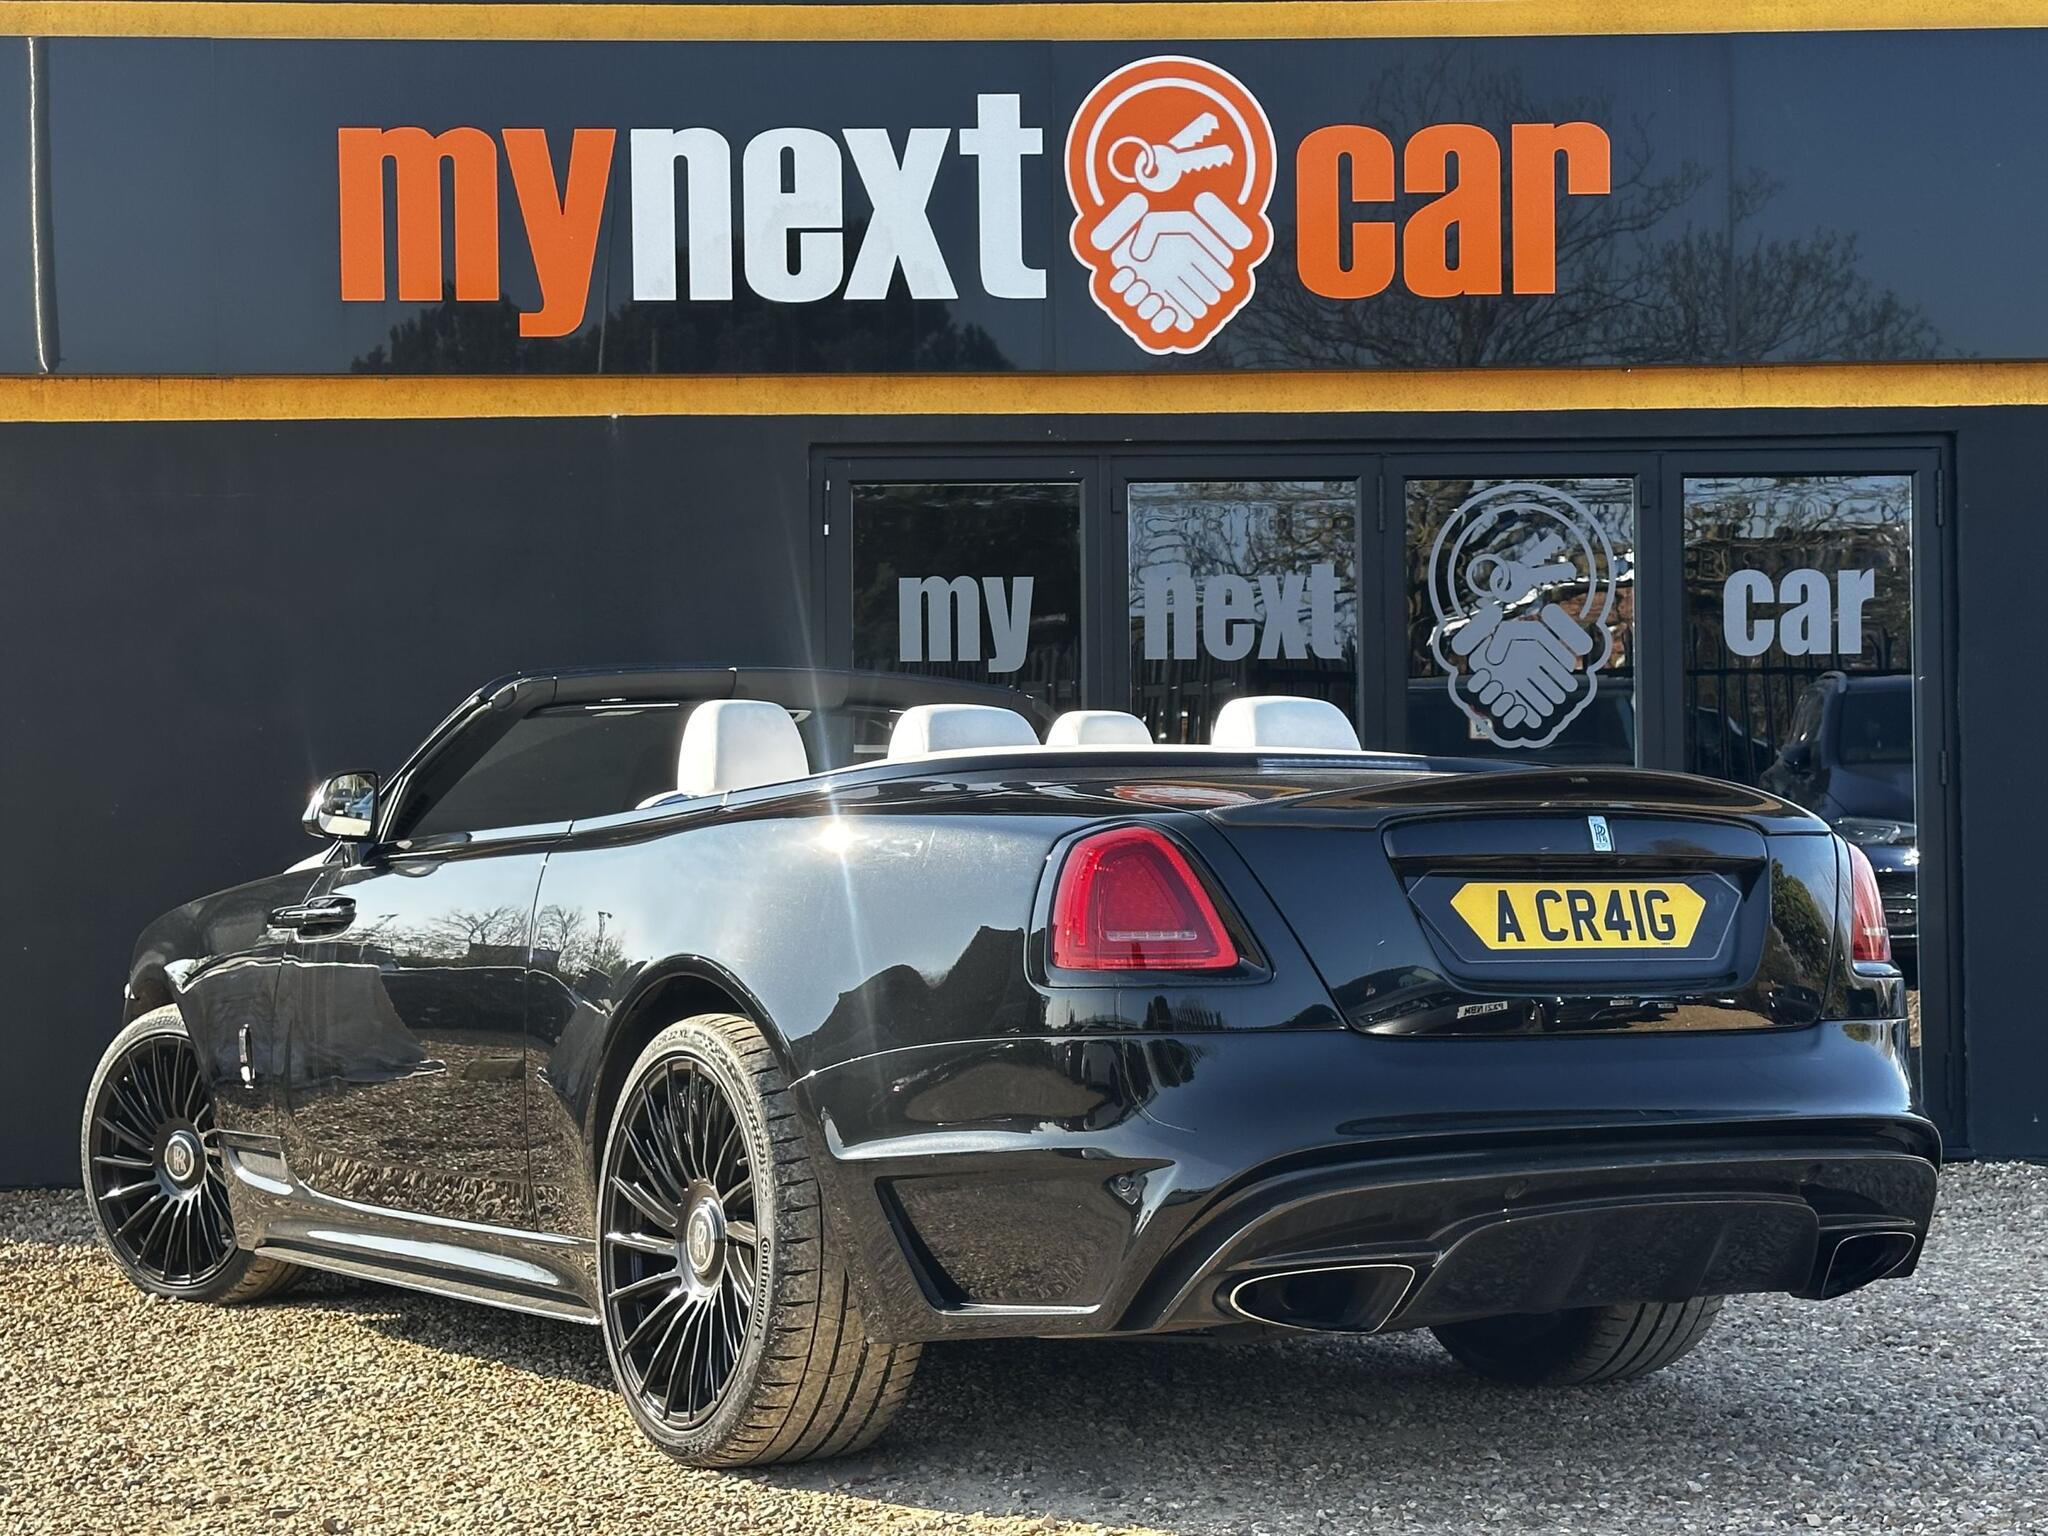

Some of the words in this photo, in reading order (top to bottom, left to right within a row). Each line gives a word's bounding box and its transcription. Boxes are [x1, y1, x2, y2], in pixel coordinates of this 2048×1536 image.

[1296, 121, 1611, 299] car
[899, 575, 1034, 673] my
[1144, 564, 1342, 661] next
[1723, 568, 1875, 656] car
[1497, 889, 1525, 942] A
